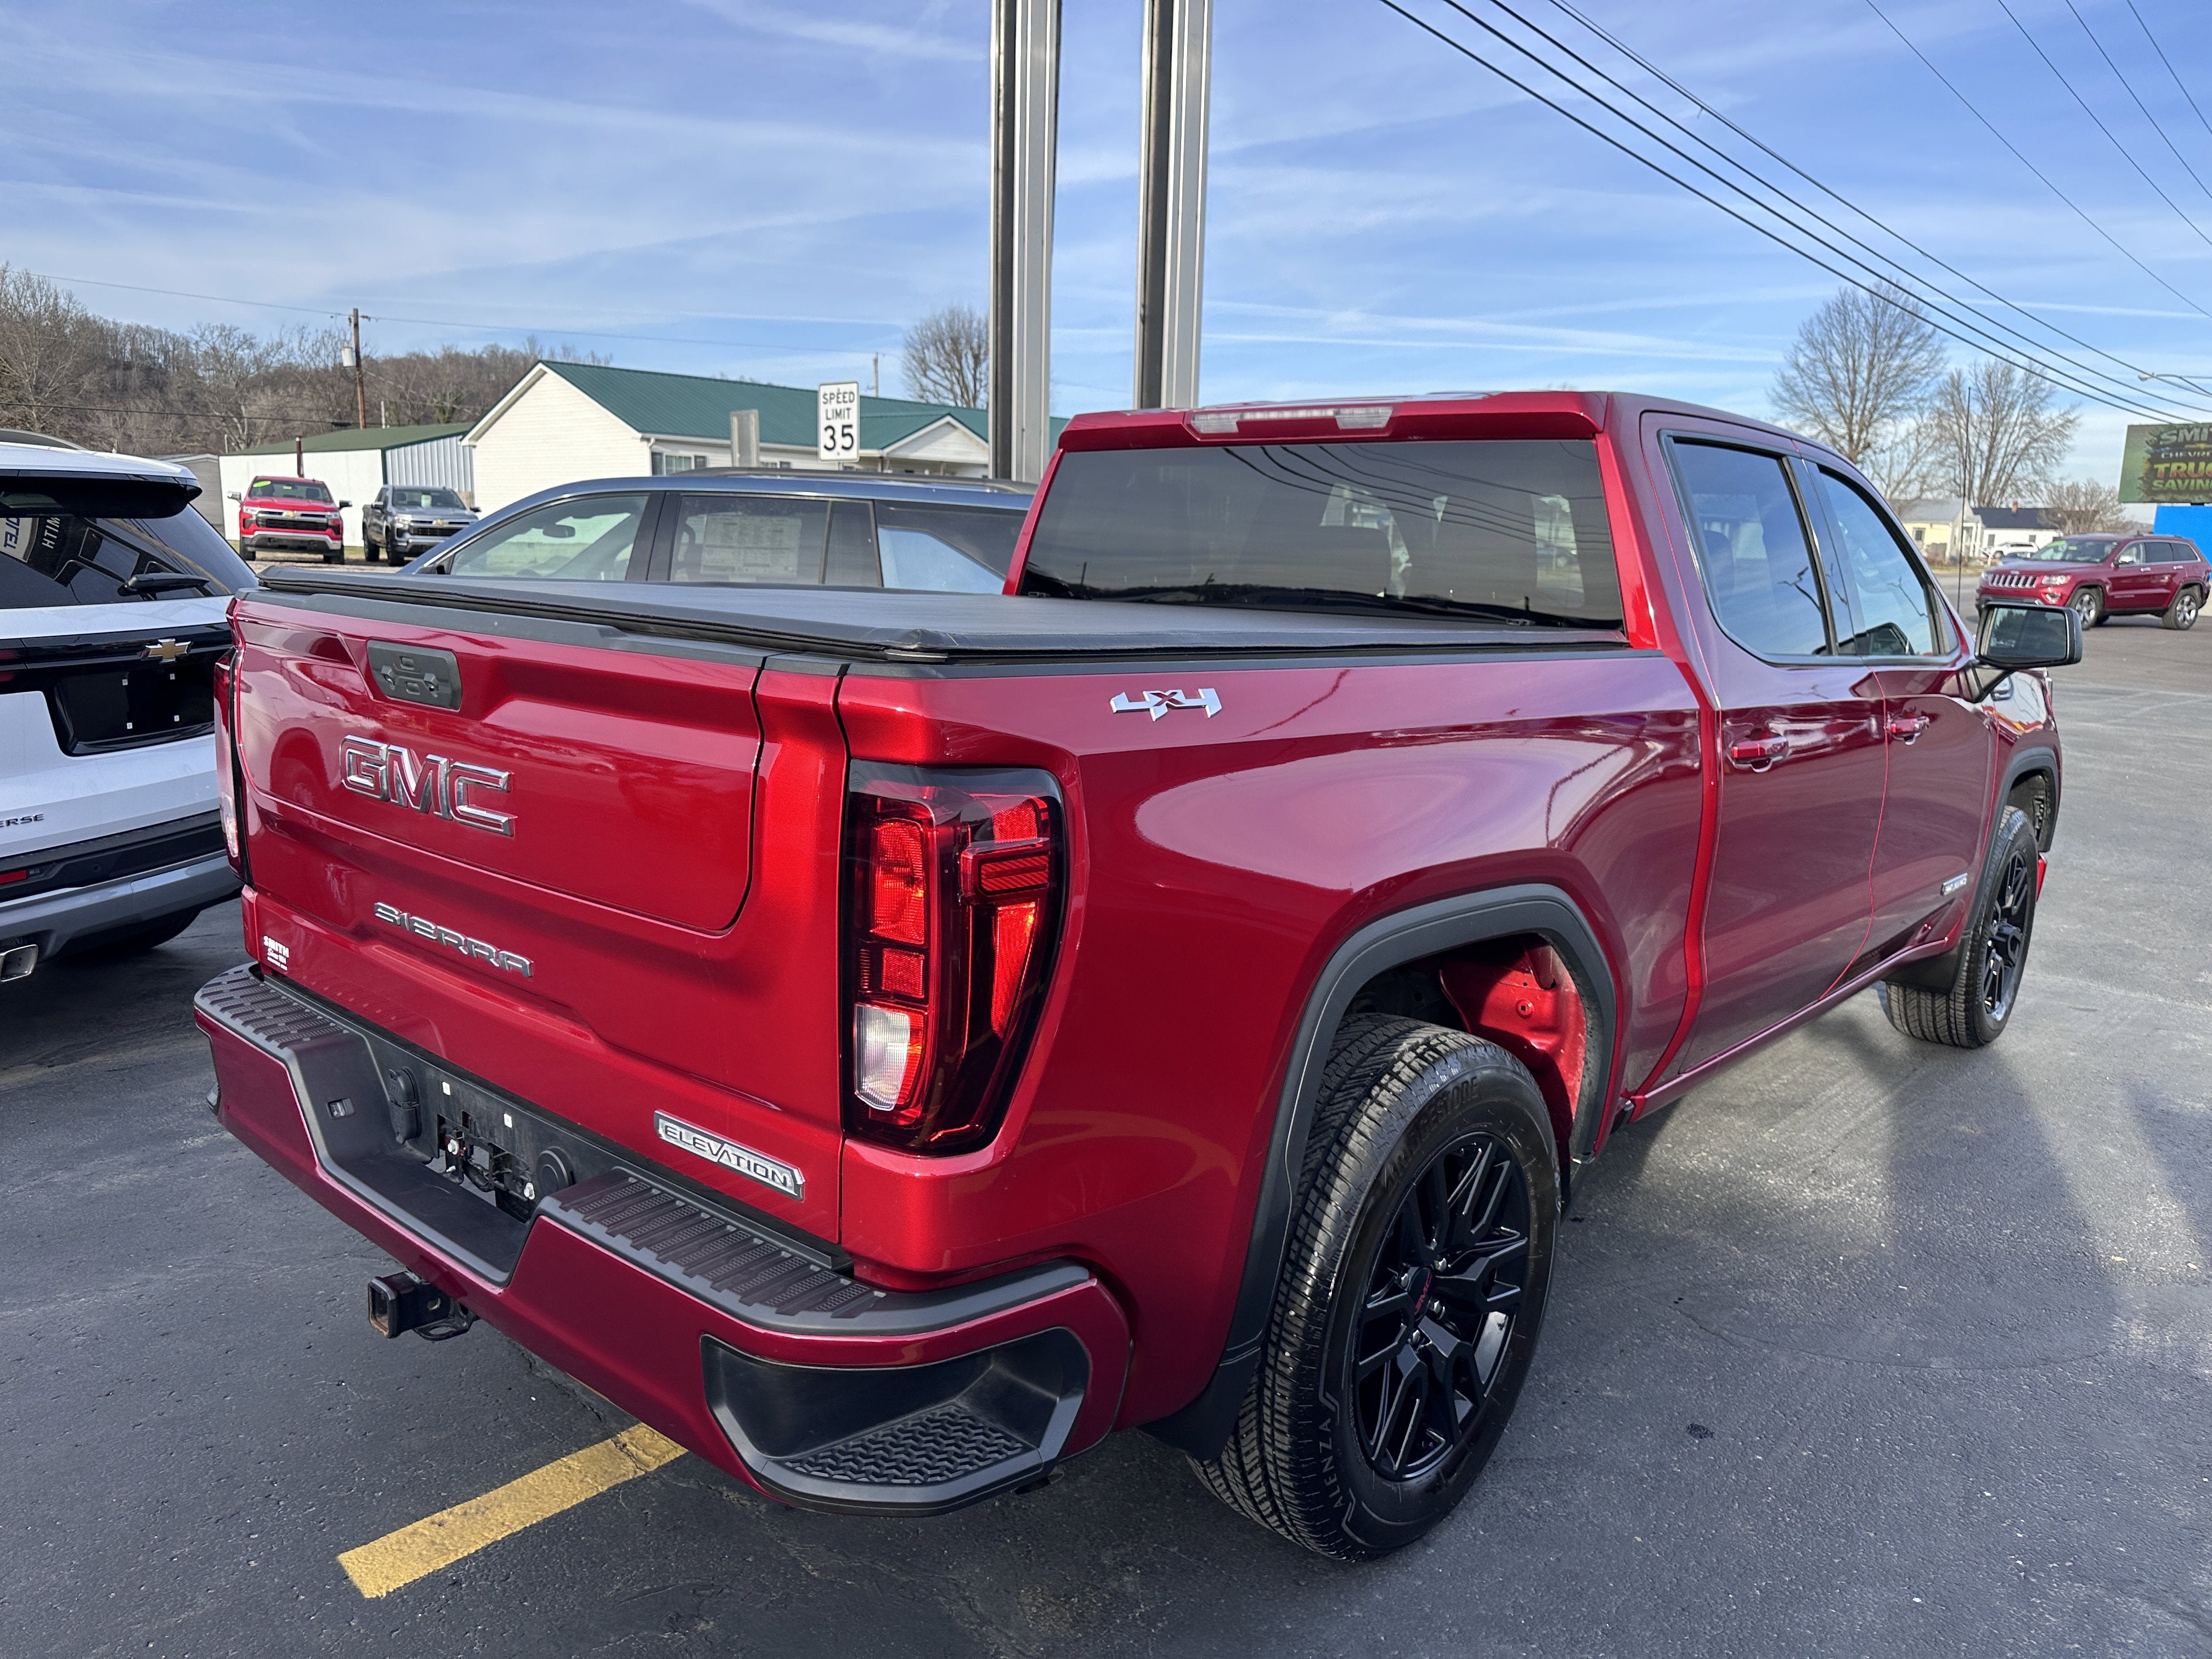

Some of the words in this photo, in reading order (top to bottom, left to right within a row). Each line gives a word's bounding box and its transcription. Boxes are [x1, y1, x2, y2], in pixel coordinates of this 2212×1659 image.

[823, 391, 855, 404] SPEED
[826, 408, 851, 421] LIMIT
[824, 425, 854, 451] 35
[2159, 428, 2212, 445] SMI
[2152, 478, 2212, 490] SAVIN
[339, 735, 515, 837] GMC
[263, 935, 290, 958] SMITH
[374, 902, 534, 978] SIERRA
[664, 1125, 788, 1187] ELEVATION
[1414, 1272, 1432, 1316] GMC
[1319, 1418, 1344, 1508] ALENZA
